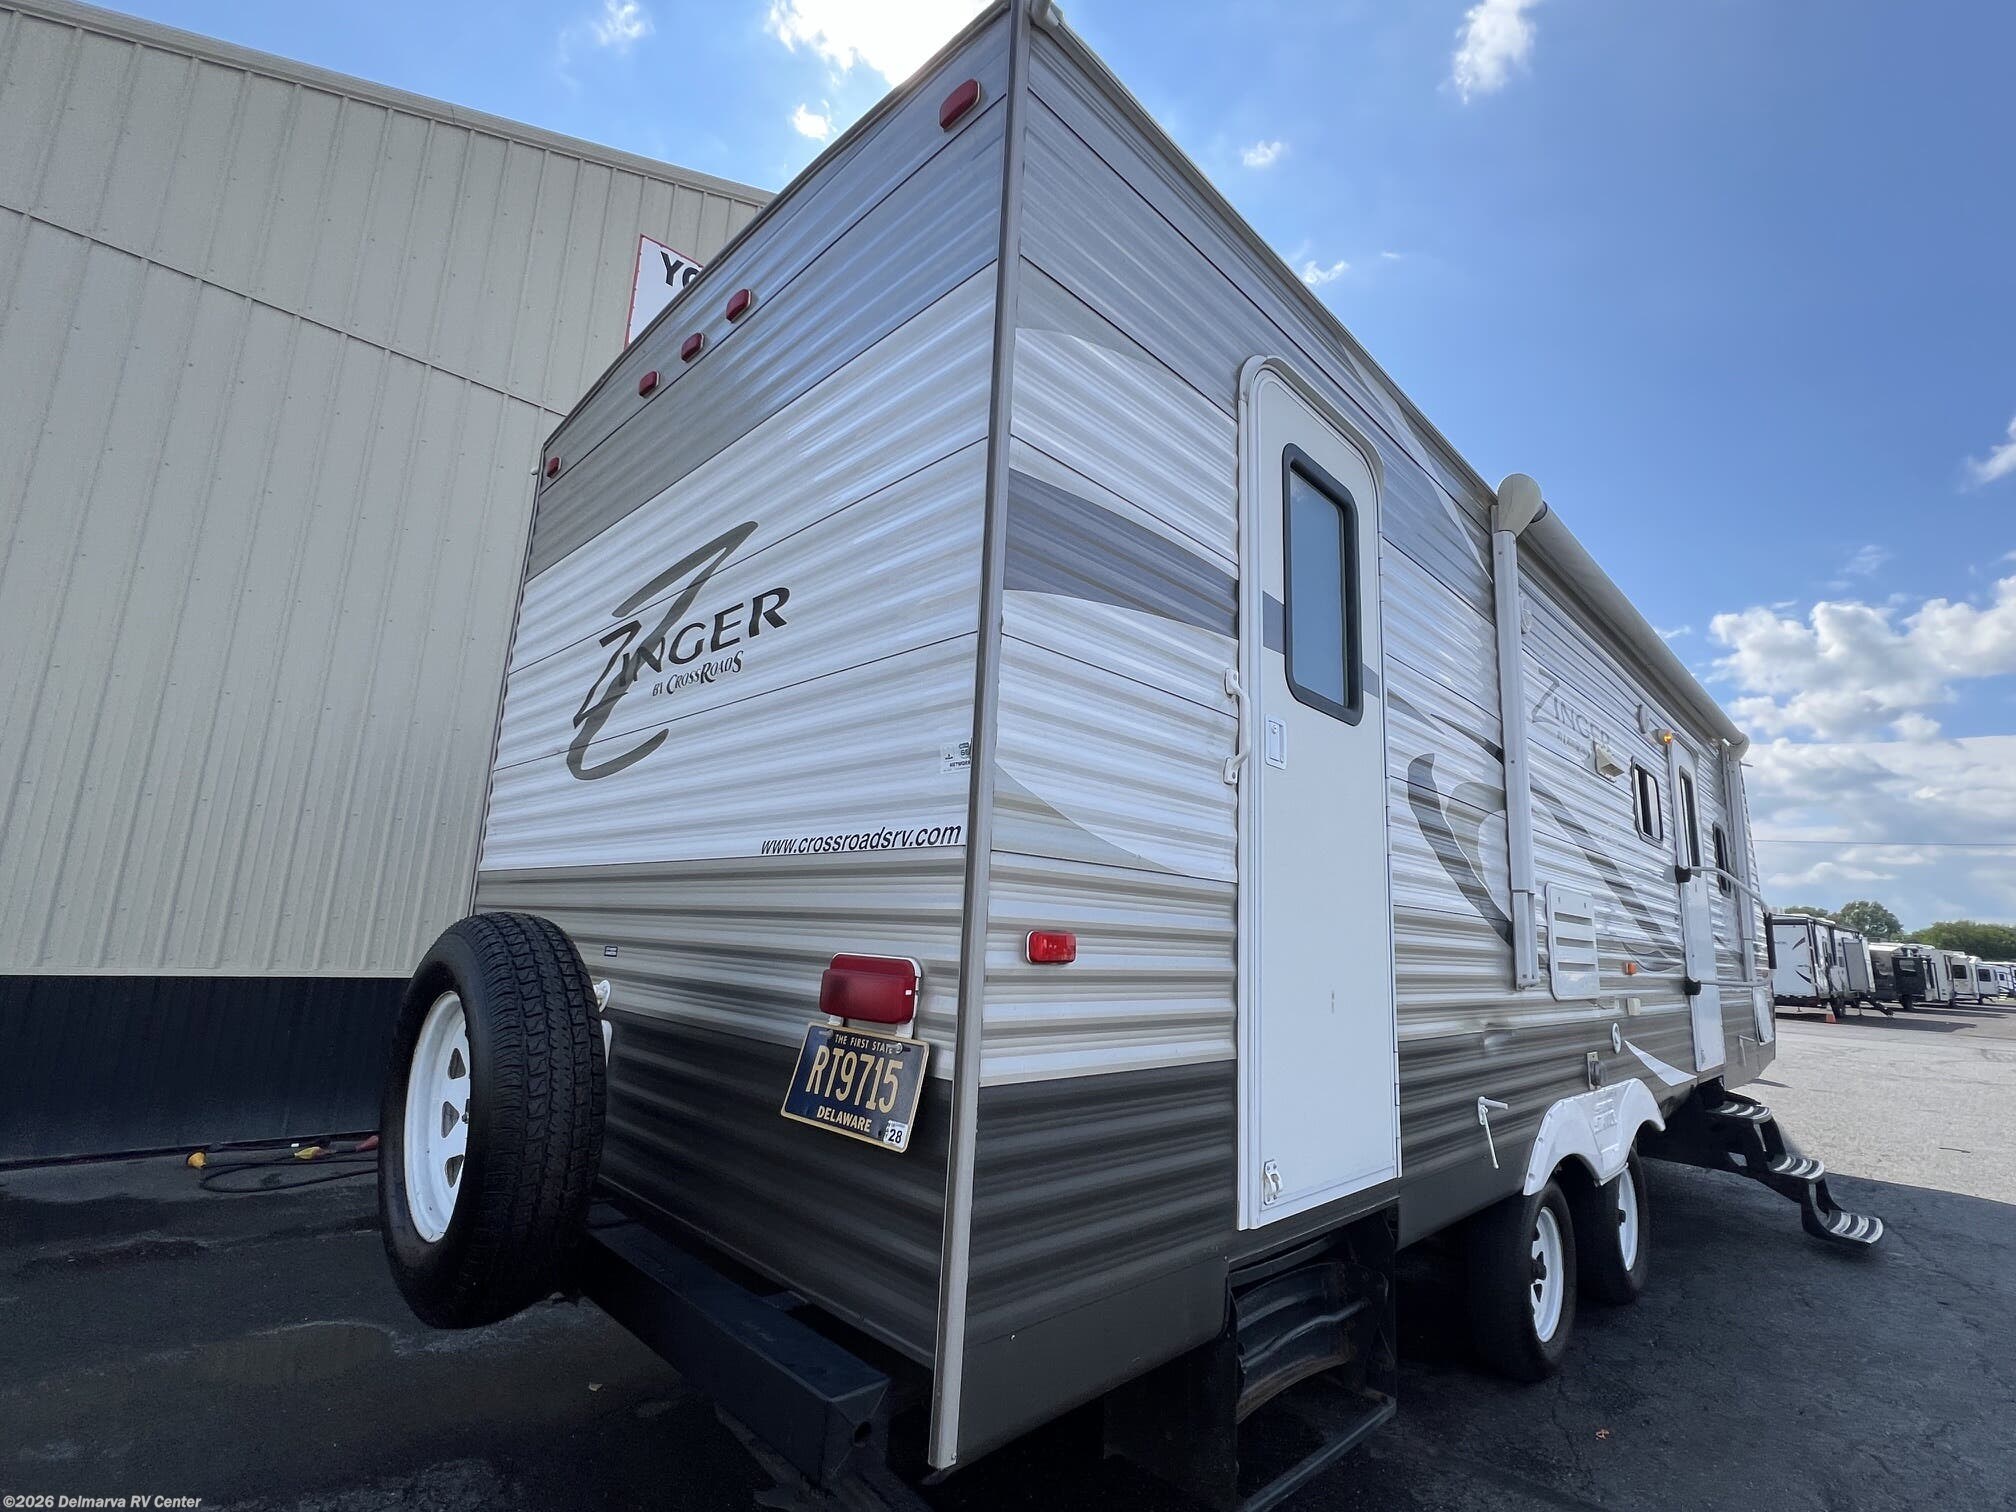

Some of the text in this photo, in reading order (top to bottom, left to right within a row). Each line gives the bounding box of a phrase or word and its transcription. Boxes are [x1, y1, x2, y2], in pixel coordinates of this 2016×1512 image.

[570, 585, 791, 731] ZINGER
[761, 825, 962, 855] www.crossroadsrv.com
[835, 1034, 893, 1055] THE FIRST STATE
[805, 1045, 904, 1114] RT9715
[816, 1105, 873, 1133] DELAWARE
[888, 1128, 903, 1144] 28
